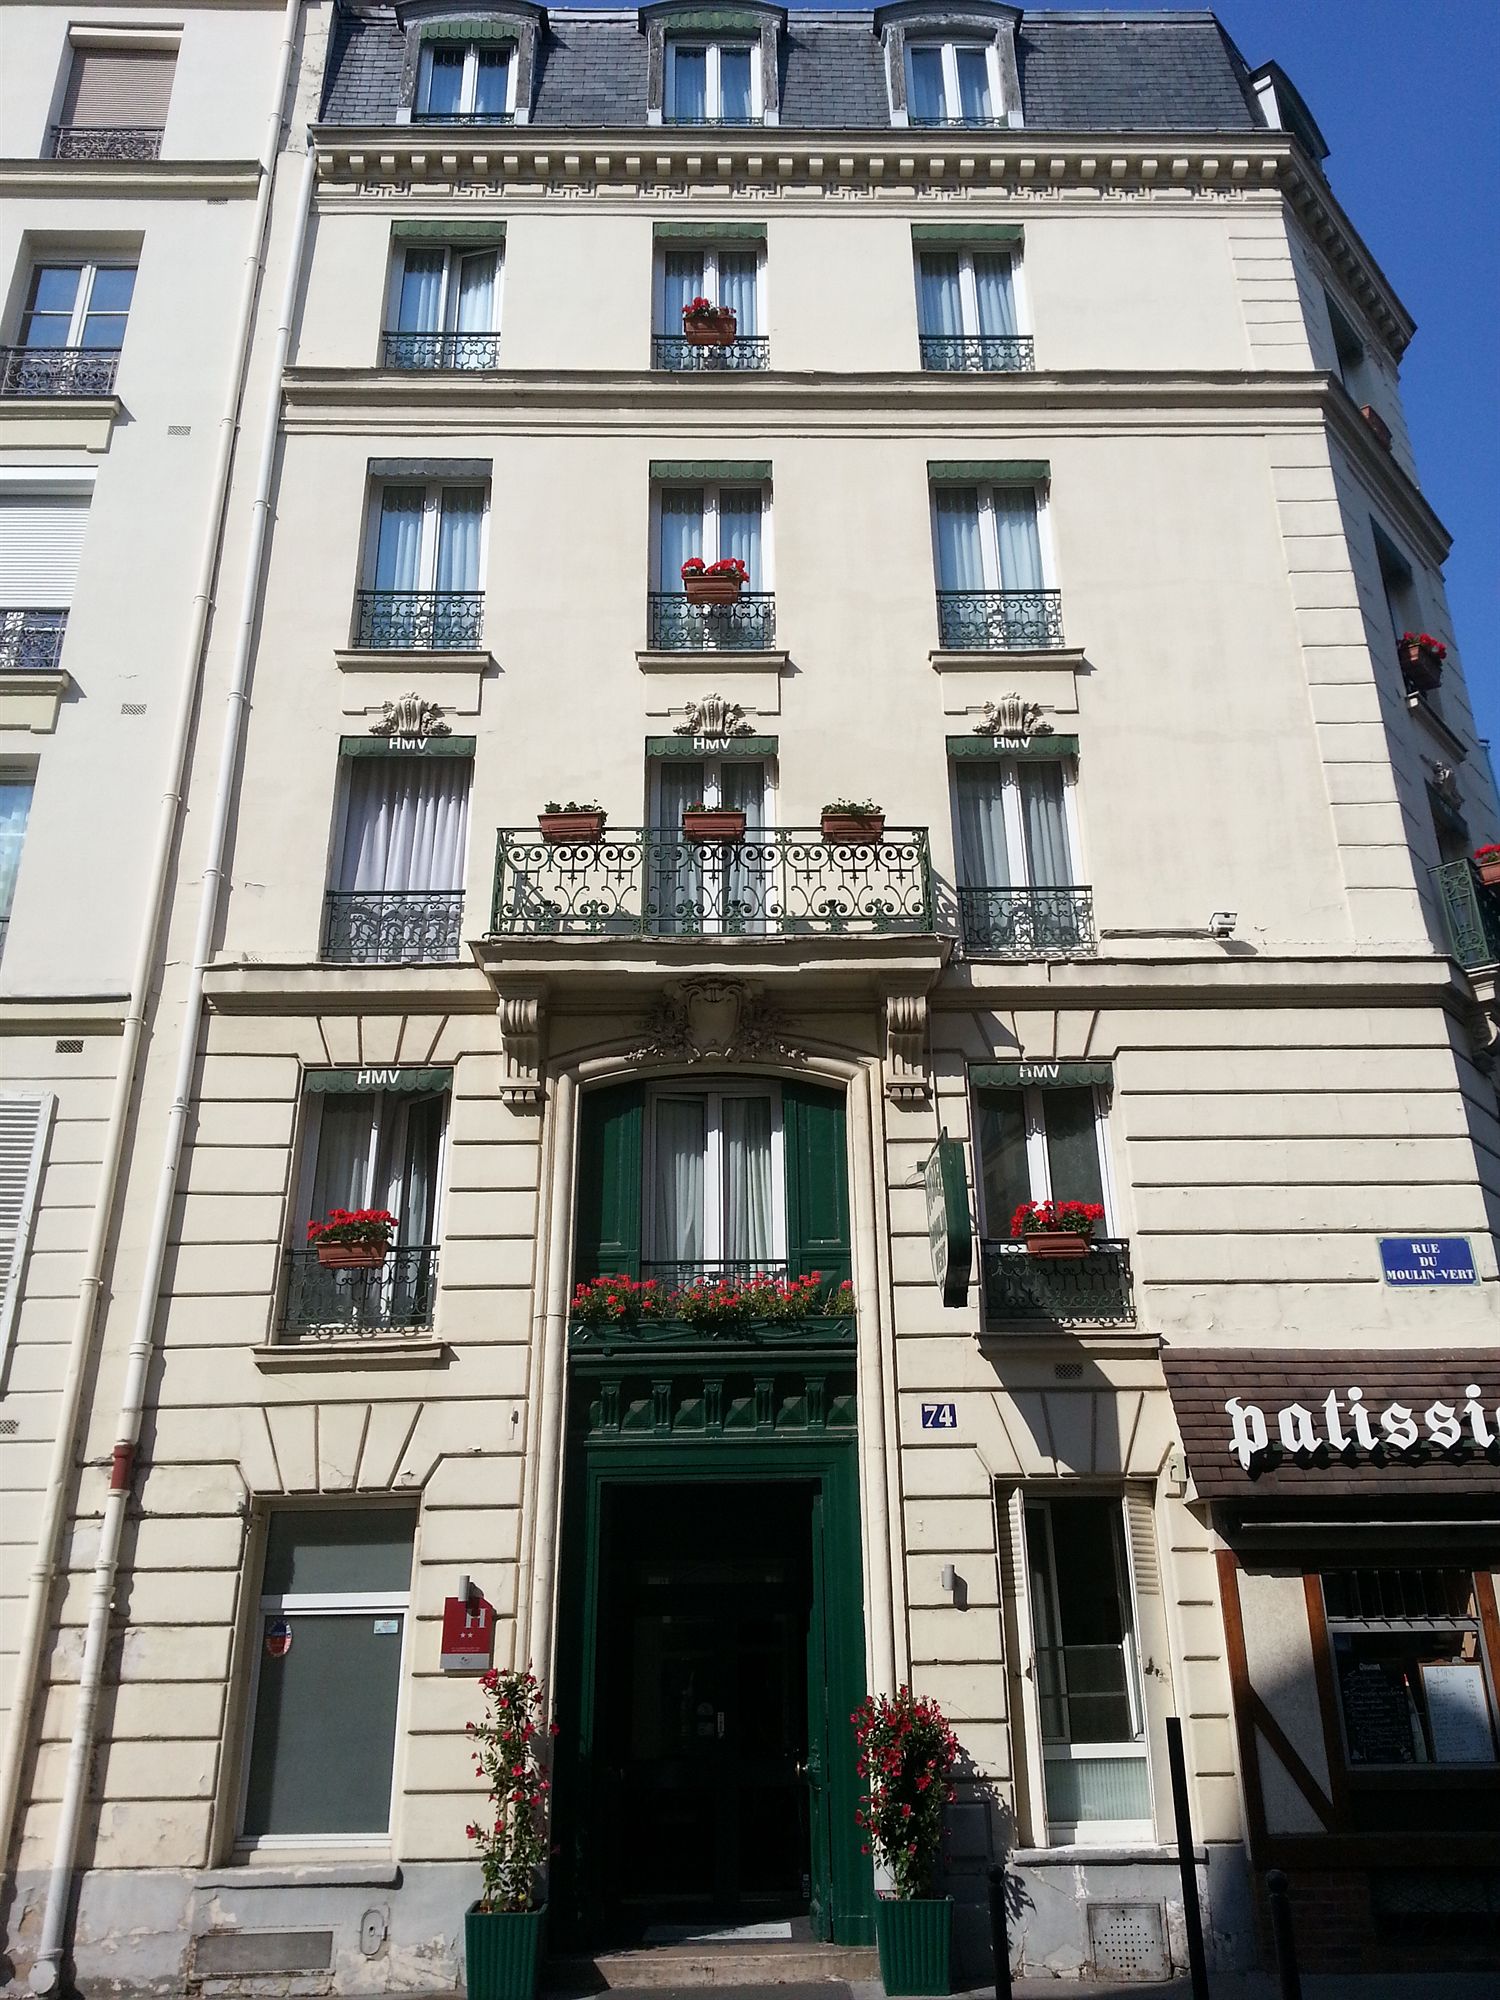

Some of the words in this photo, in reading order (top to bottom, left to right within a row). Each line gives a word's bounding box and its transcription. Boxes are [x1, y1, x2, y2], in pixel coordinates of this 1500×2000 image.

[389, 737, 428, 750] HMV
[693, 737, 731, 750] HMV
[993, 736, 1031, 749] HMV
[357, 1069, 401, 1085] HMV
[1019, 1064, 1060, 1078] HMV
[1411, 1243, 1440, 1254] RUE
[1419, 1256, 1438, 1267] DU
[1387, 1269, 1474, 1280] MOULIN-VERT
[924, 1405, 953, 1427] 74
[1224, 1383, 1500, 1471] patissi
[465, 1608, 487, 1629] H
